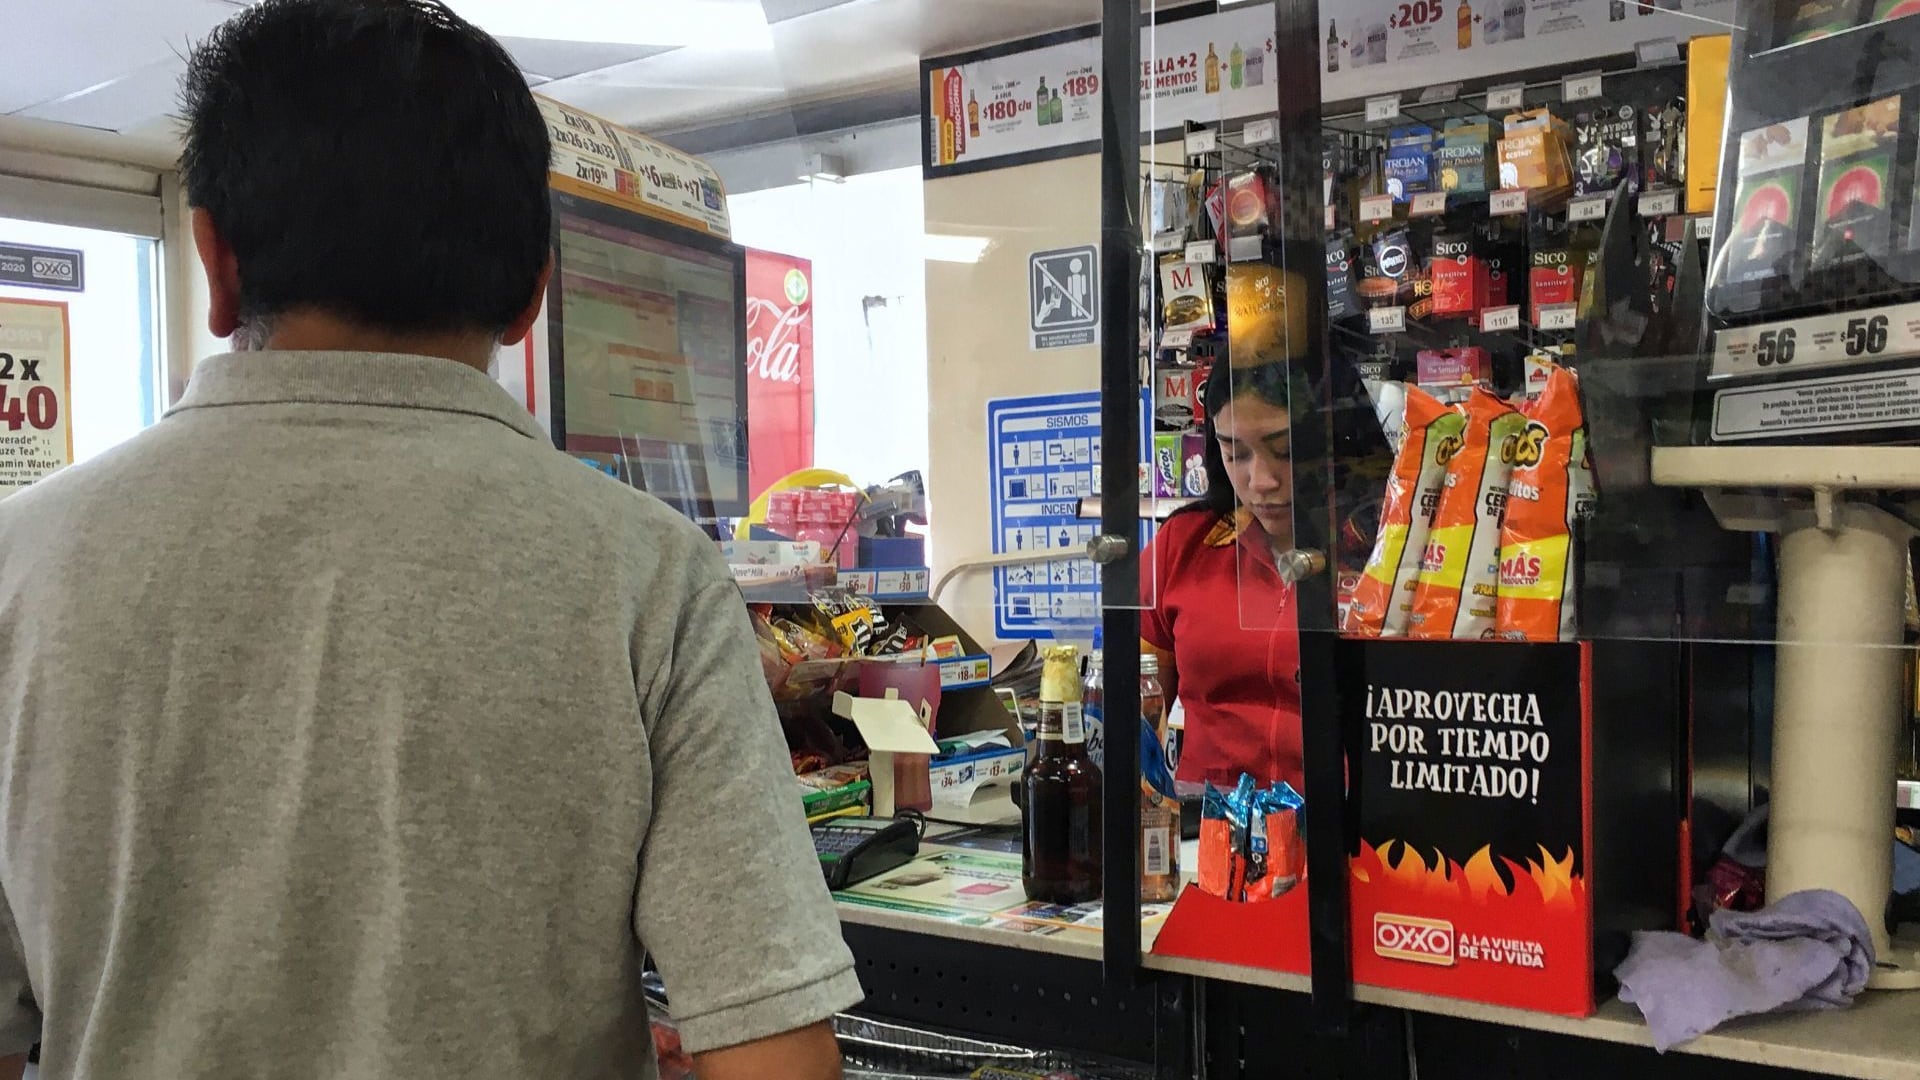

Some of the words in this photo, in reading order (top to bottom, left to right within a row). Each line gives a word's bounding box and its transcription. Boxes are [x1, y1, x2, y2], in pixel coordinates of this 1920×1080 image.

[1390, 0, 1443, 29] $205
[1063, 75, 1098, 97] $189
[1140, 71, 1198, 91] PLMENTOS
[983, 99, 1017, 120] $180
[1386, 156, 1425, 169] TROJAN
[1440, 145, 1481, 159] TROJAN
[1326, 249, 1345, 265] ICO
[1436, 241, 1467, 256] SICO
[1534, 251, 1566, 267] SICO
[1, 262, 26, 273] 2020
[33, 261, 71, 276] OXXO
[1171, 266, 1193, 291] M
[1840, 314, 1889, 357] $56
[1752, 327, 1797, 367] $56
[1165, 376, 1187, 398] M
[1046, 415, 1089, 428] SISMOS
[1501, 551, 1541, 578] MÁS
[1365, 684, 1543, 726] ¡APROVECHA
[1370, 723, 1427, 753] POR
[1437, 728, 1550, 763] TIEMPO
[1390, 761, 1541, 805] LIMITADO!
[1377, 924, 1450, 954] OXXO
[1460, 933, 1470, 945] A
[1472, 934, 1490, 948] LA
[1491, 937, 1544, 955] VUELTA
[1459, 945, 1479, 959] DE
[1481, 948, 1503, 962] TU
[1505, 951, 1544, 968] VIDA
